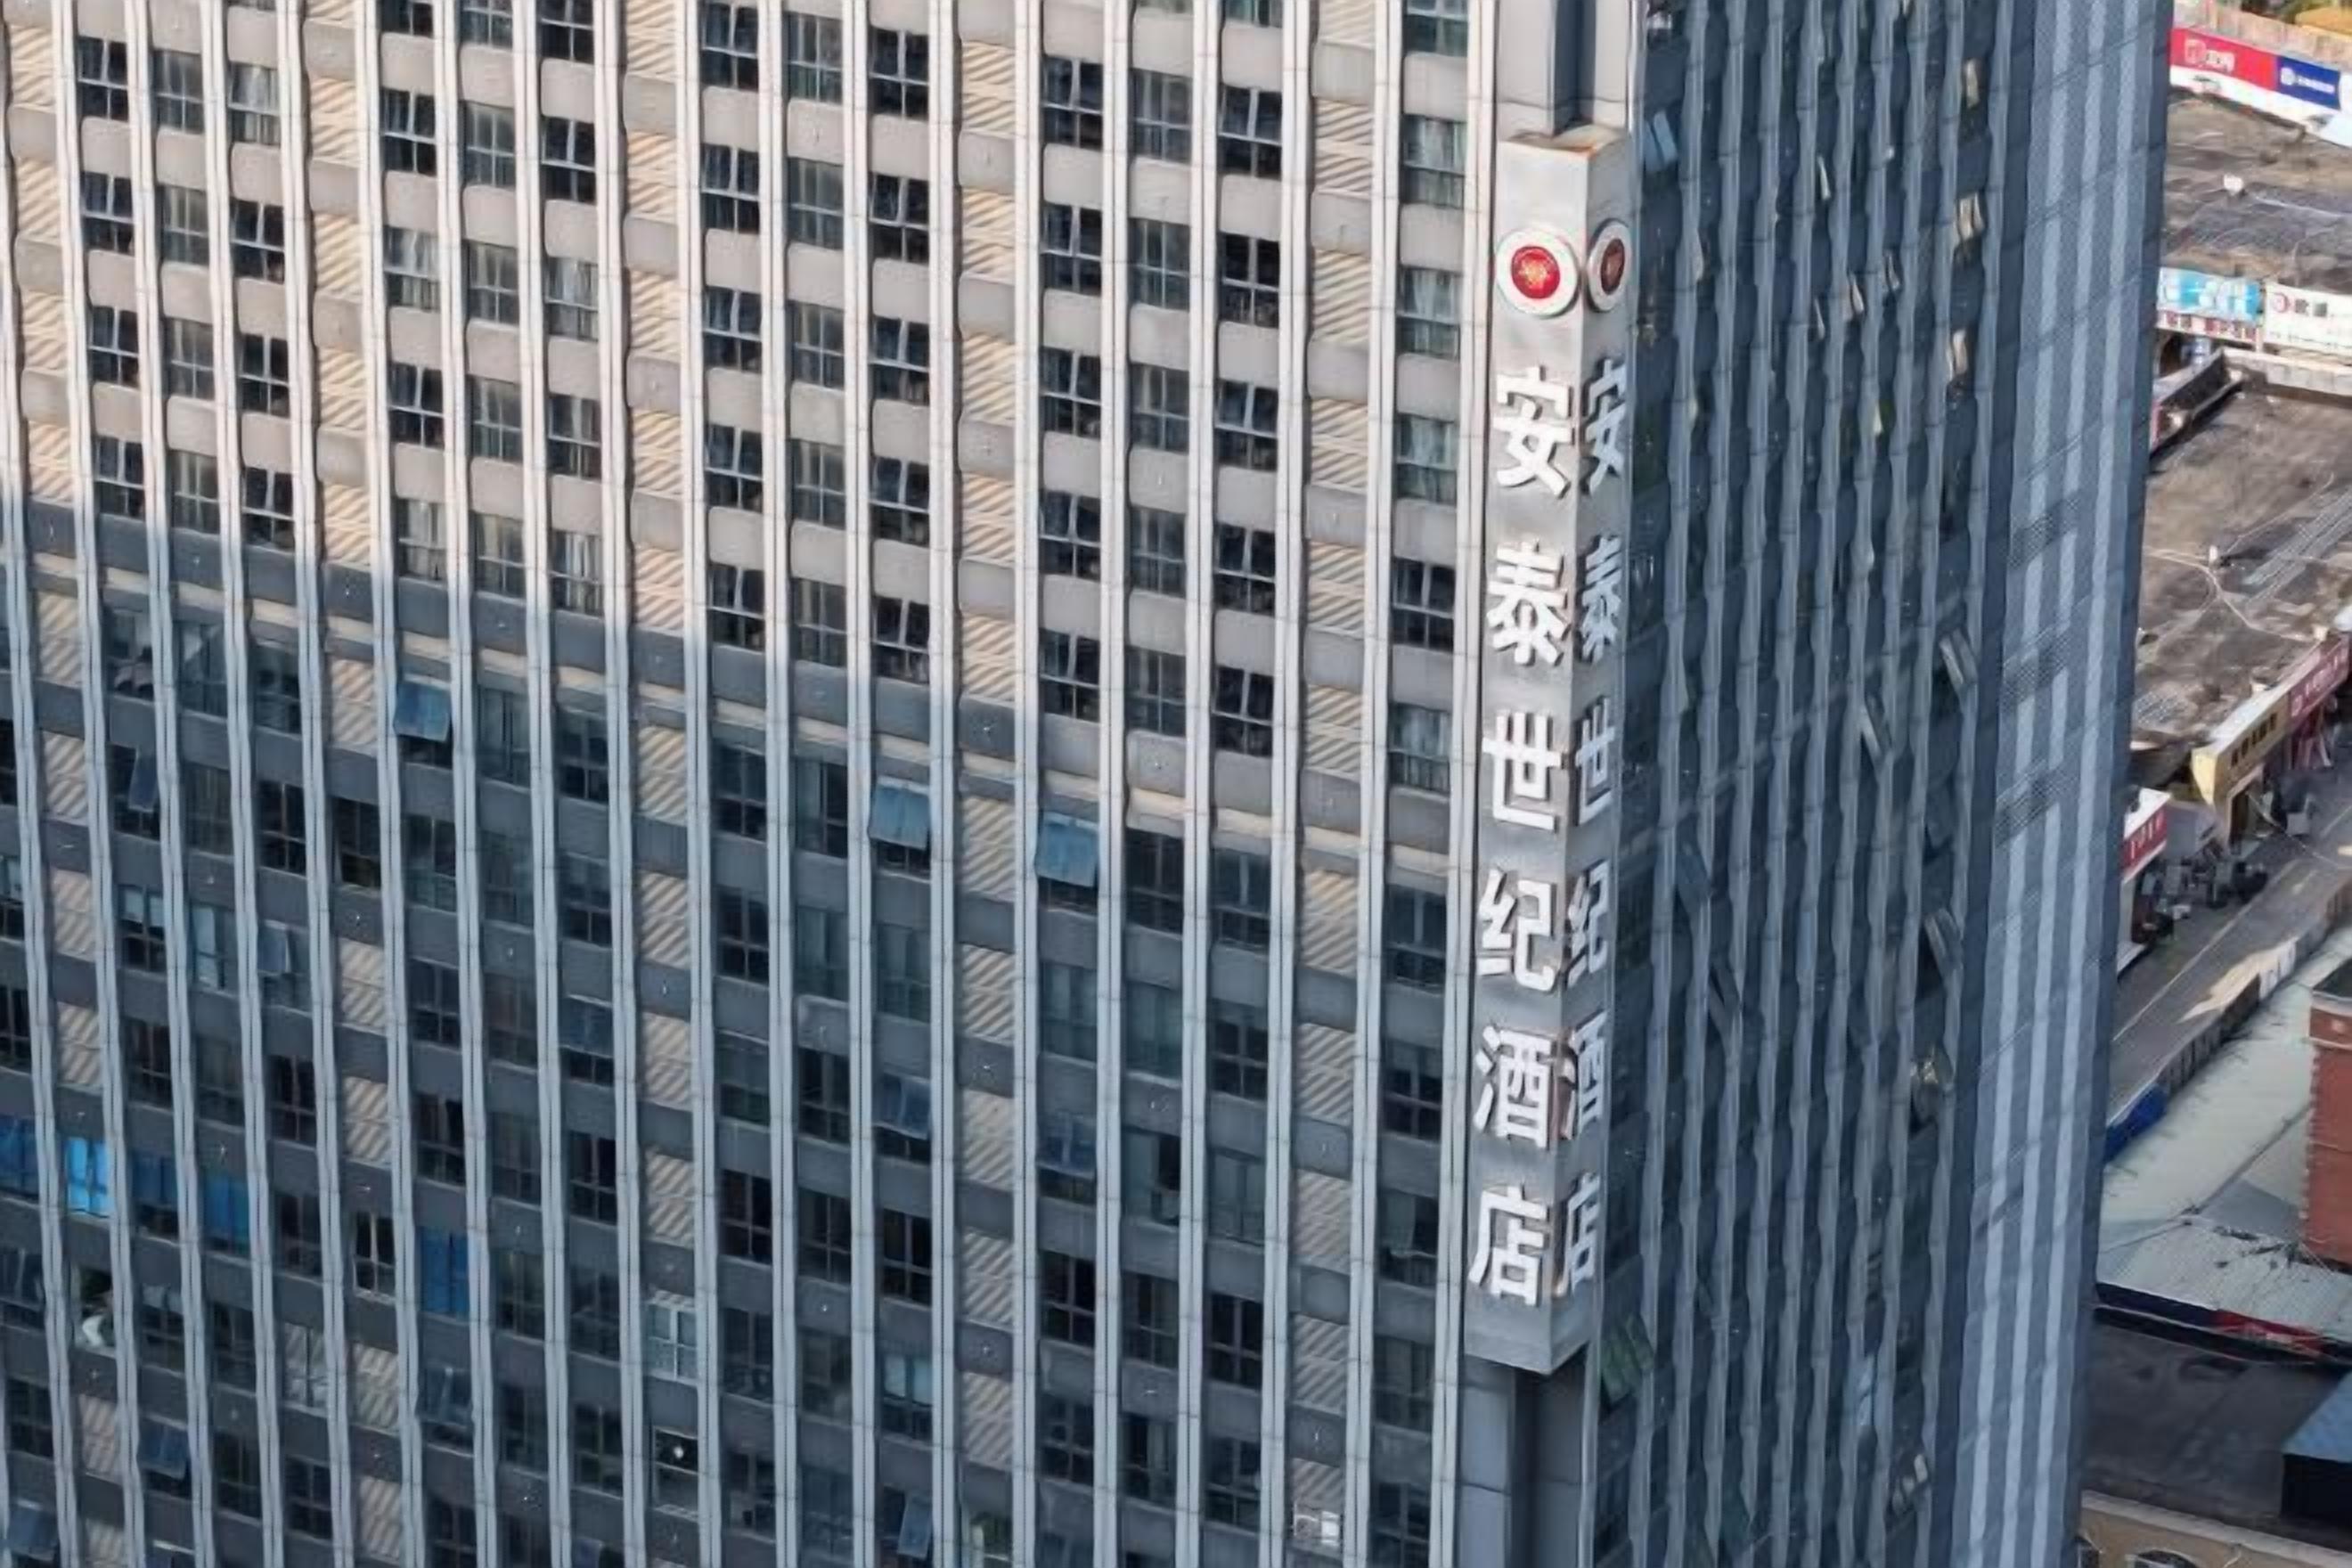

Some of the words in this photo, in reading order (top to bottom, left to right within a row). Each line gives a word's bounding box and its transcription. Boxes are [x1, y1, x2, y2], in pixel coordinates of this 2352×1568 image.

[1468, 365, 1573, 1306] 安泰世纪酒店
[1554, 358, 1627, 1296] 安泰世纪酒店
